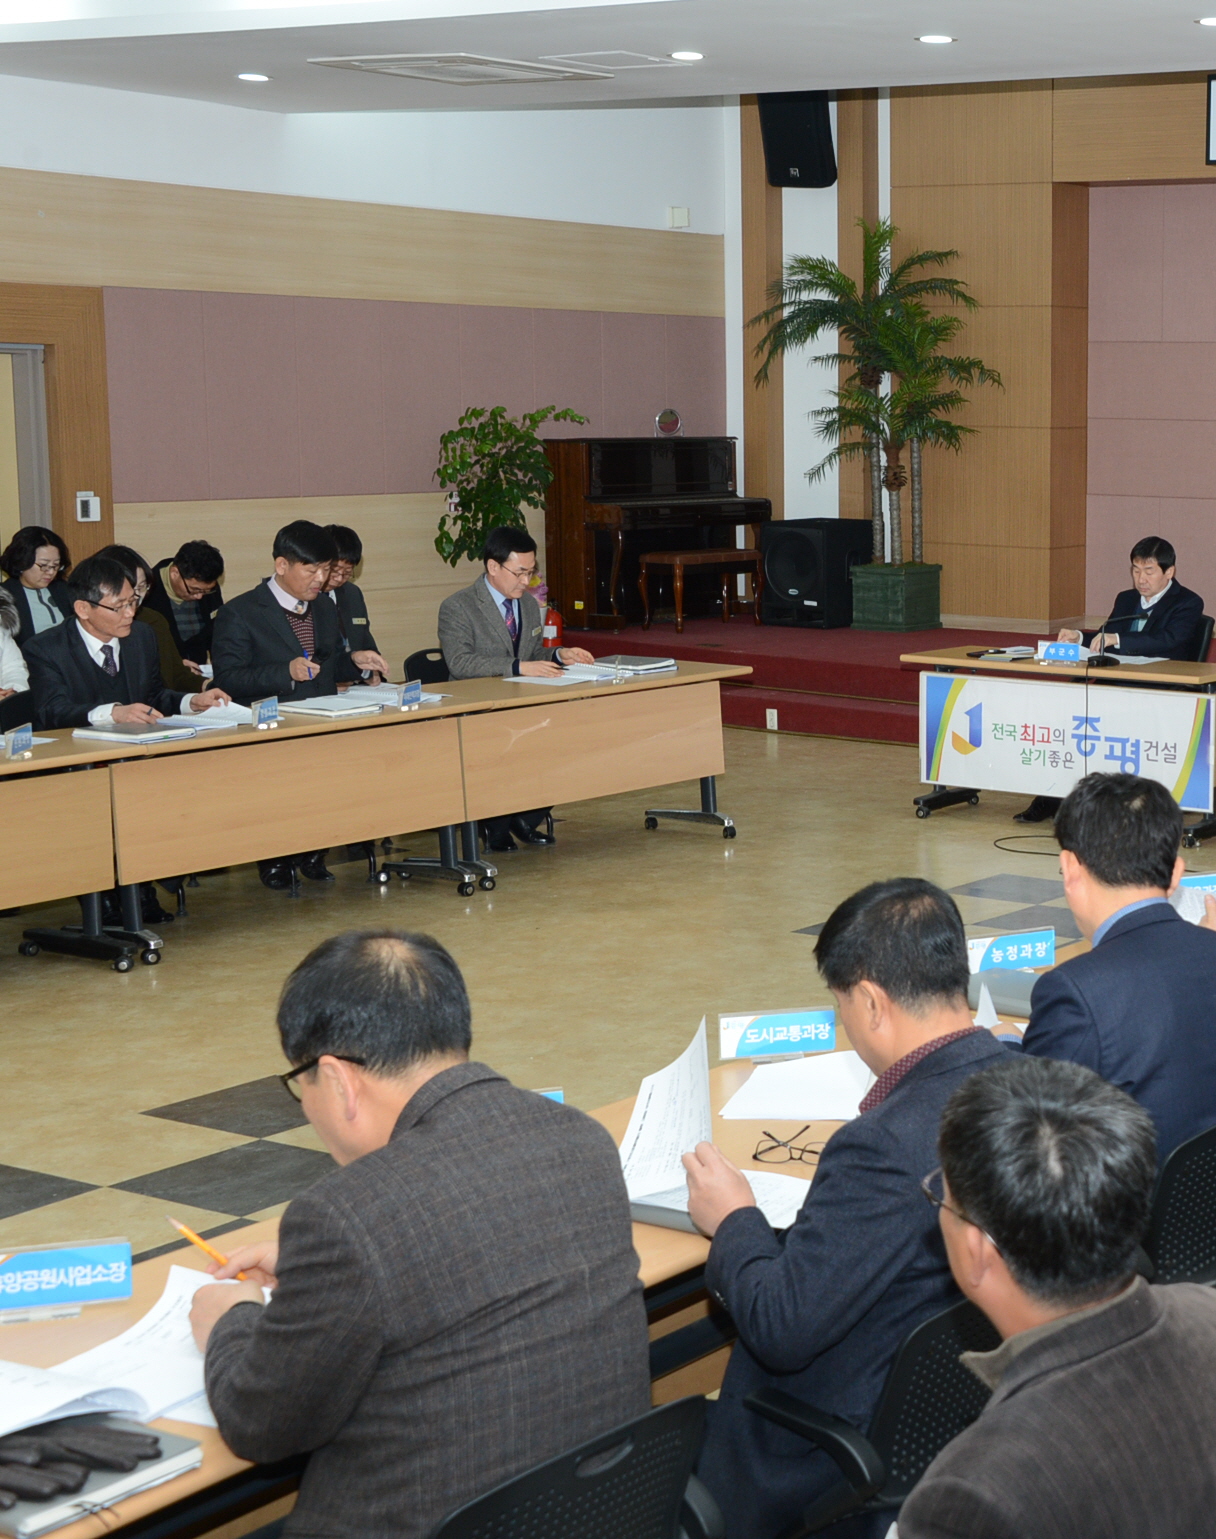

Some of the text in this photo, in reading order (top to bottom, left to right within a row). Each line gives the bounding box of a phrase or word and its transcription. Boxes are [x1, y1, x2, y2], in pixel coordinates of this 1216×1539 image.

[991, 722, 1018, 742] 전국
[990, 941, 1048, 964] 농정과장
[744, 1022, 831, 1044] 도시교통과장
[0, 1261, 128, 1294] 양공원사업소장
